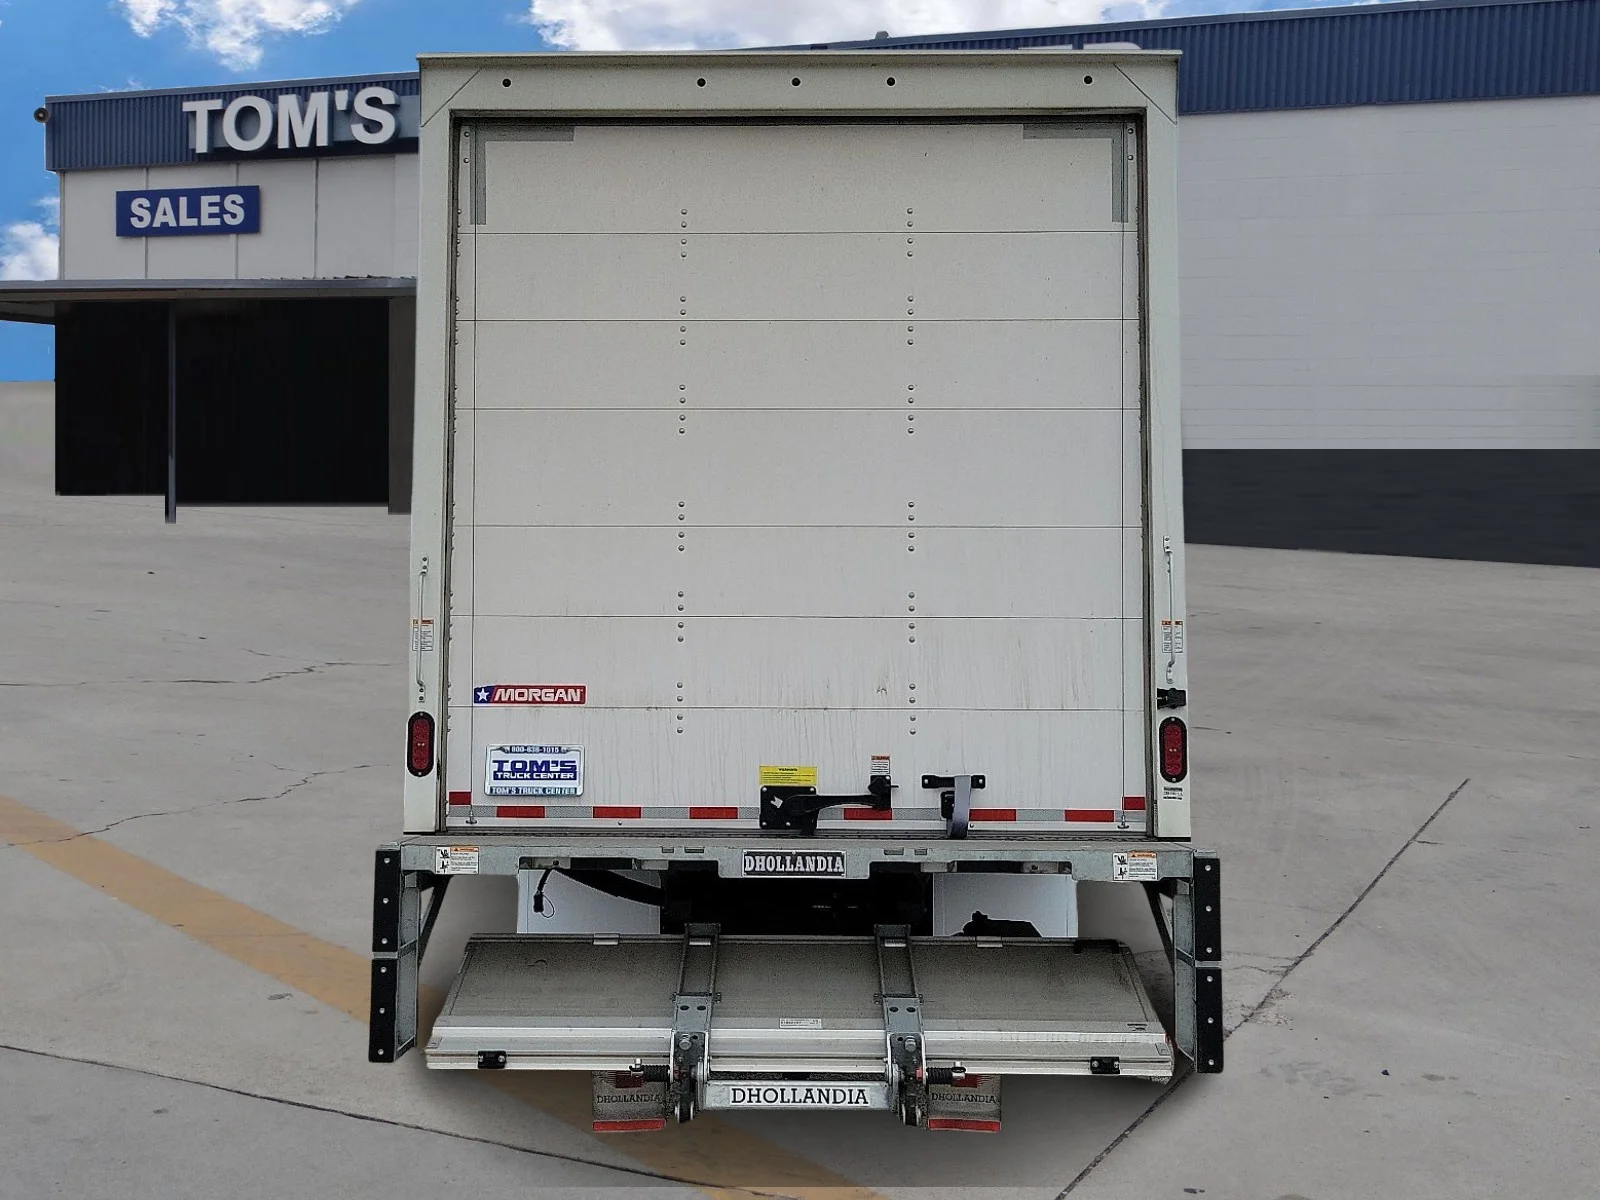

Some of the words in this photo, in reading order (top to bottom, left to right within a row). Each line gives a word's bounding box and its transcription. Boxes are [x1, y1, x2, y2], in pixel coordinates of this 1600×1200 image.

[182, 86, 400, 154] TOM'S
[130, 194, 245, 229] SALES
[494, 688, 581, 702] MORGAN
[492, 759, 578, 772] TOM'S
[492, 787, 517, 795] TOM'S
[519, 787, 544, 795] TRUCK
[545, 787, 575, 795] CENTER
[744, 855, 844, 872] DHOLLANDIA
[597, 1094, 661, 1104] DHOLLANDIA
[731, 1087, 869, 1105] DHOLLANDIA
[931, 1092, 996, 1104] DHOLLANDIA
